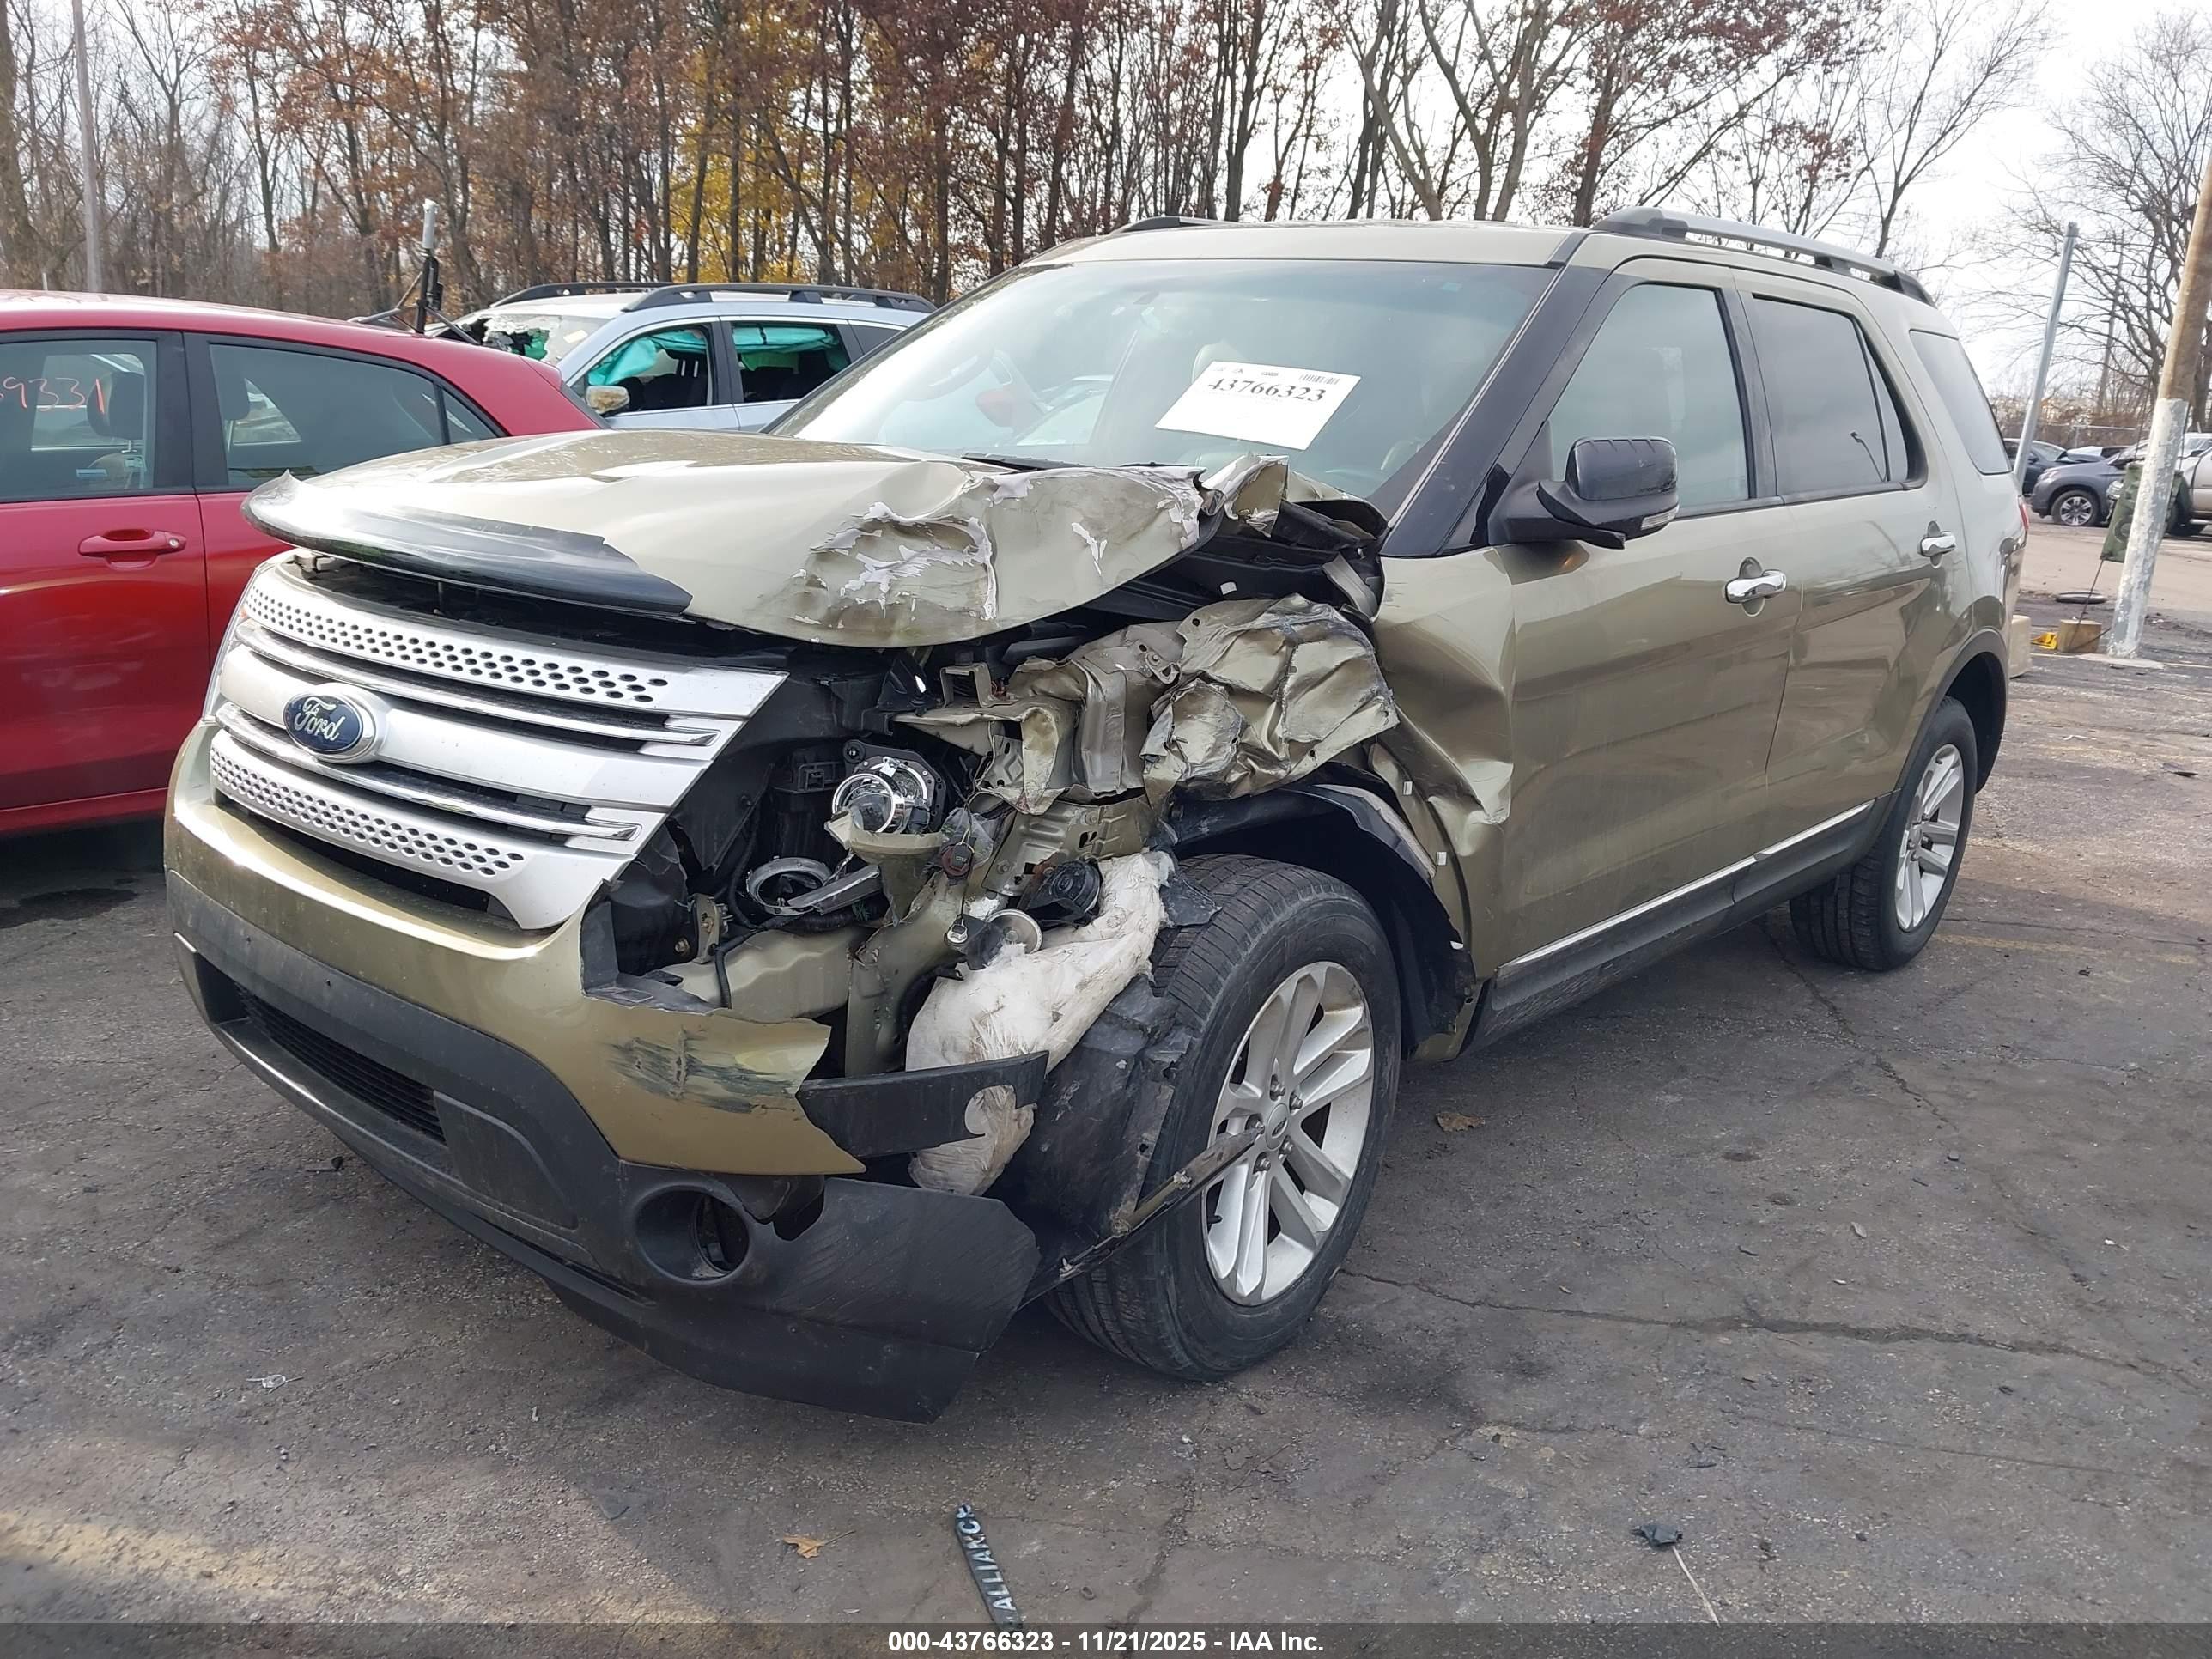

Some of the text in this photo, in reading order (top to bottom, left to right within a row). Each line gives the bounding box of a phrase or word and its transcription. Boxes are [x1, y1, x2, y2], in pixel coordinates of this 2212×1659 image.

[0, 376, 106, 415] 9331
[1208, 378, 1327, 403] 43766323
[294, 696, 346, 741] Ford
